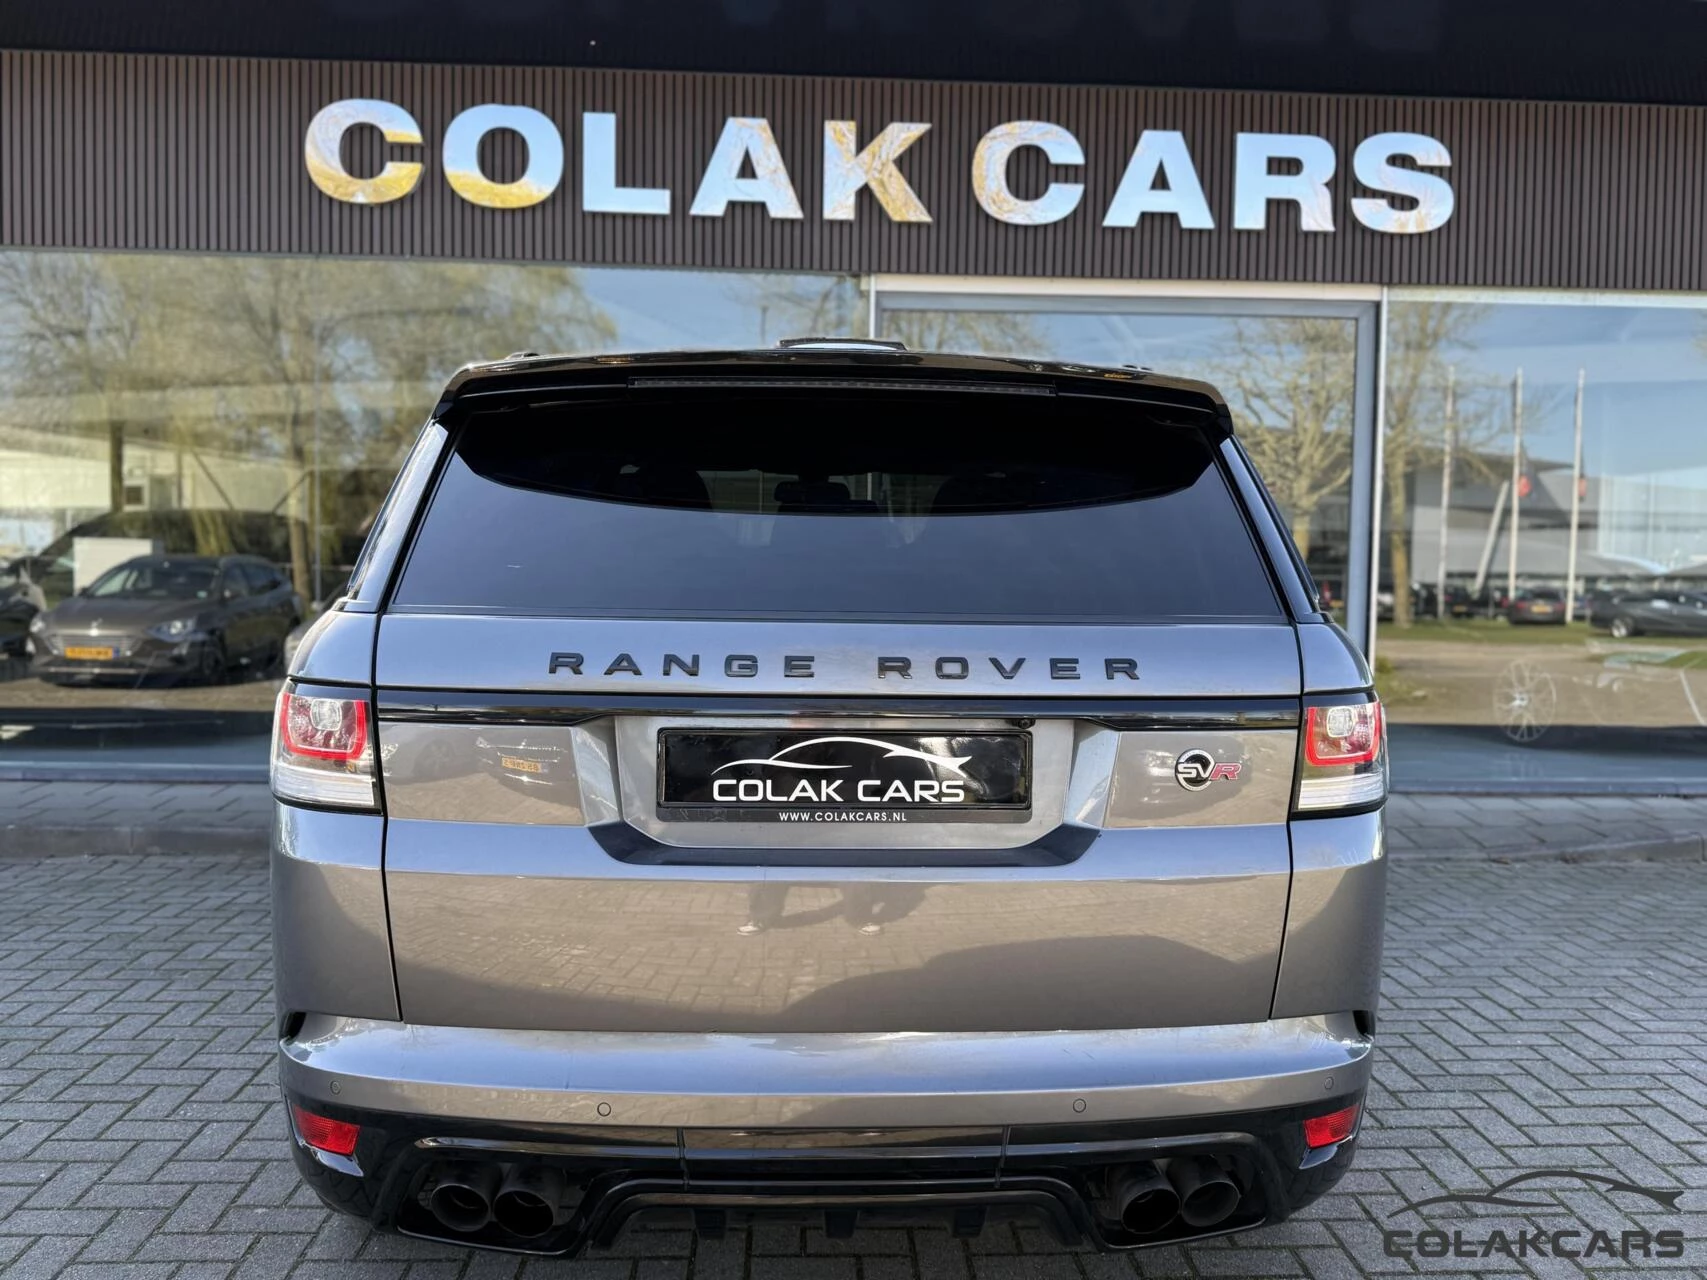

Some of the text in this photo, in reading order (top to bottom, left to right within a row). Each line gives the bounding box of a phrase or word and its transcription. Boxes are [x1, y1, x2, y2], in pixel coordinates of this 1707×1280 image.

[305, 98, 1455, 234] COLAK CARS
[548, 651, 1140, 680] RANGE ROVER
[1175, 749, 1241, 791] SVR
[712, 779, 965, 802] COLAK CARS
[778, 811, 907, 822] WWW.COLAKCARS.NL
